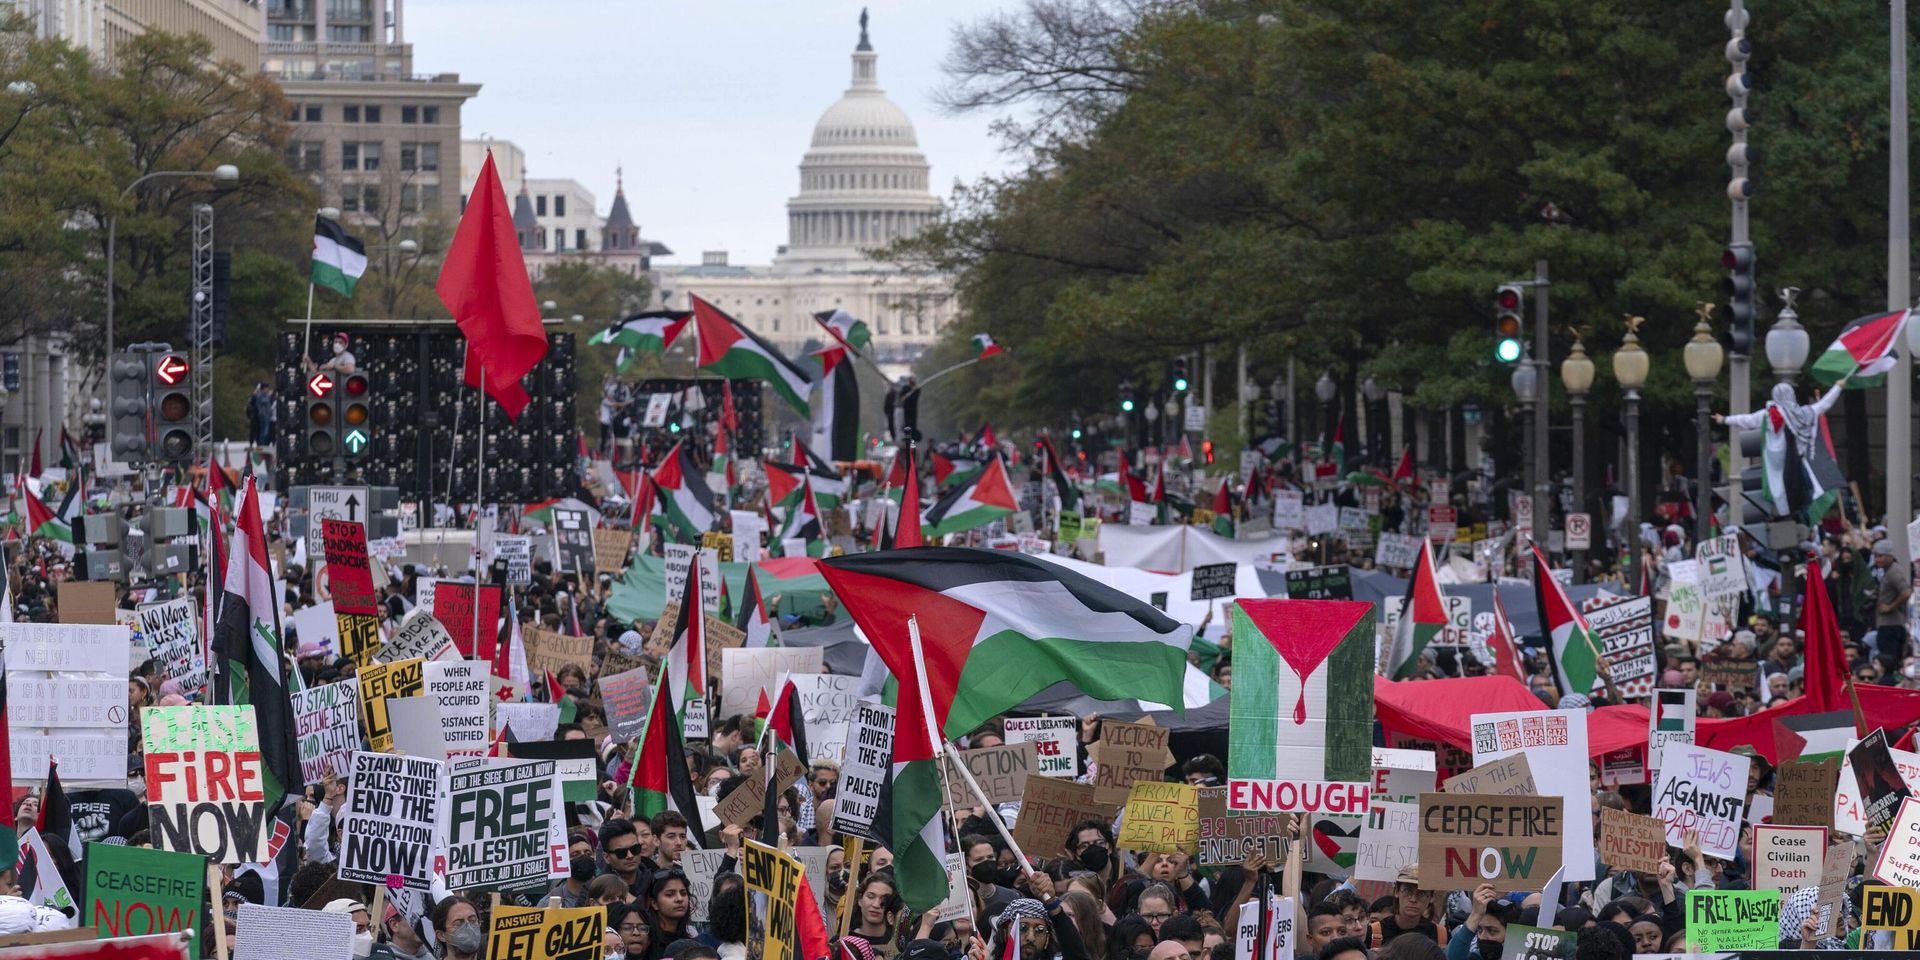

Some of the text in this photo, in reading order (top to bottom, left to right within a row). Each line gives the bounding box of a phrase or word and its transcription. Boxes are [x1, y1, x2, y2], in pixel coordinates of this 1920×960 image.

[313, 492, 339, 503] THRU
[329, 522, 358, 538] STOP
[323, 537, 366, 553] FUNDING
[326, 555, 369, 569] GENOCIDE
[141, 605, 190, 634] NO More
[154, 626, 184, 645] USA
[190, 633, 200, 655] 4
[379, 613, 434, 663] JOE BIDEN
[168, 663, 193, 679] thnic
[362, 666, 387, 681] ANSWER
[444, 666, 471, 677] WHEN
[67, 683, 91, 699] NO
[99, 684, 122, 699] TO
[362, 675, 388, 702] LET
[430, 680, 484, 692] PEOPLE ARE
[817, 675, 849, 691] NO
[306, 683, 339, 713] STAND
[342, 699, 356, 721] TO
[858, 707, 890, 731] FROM
[144, 707, 258, 754] CEASE
[441, 716, 485, 728] SISTANCE
[1005, 719, 1075, 731] QUEER LIBERATION
[297, 722, 357, 761] TAND WITH
[444, 730, 484, 742] USTIFIED
[858, 726, 889, 749] RIVER
[1103, 725, 1166, 750] VICTORY
[1500, 731, 1520, 742] GAZA
[1524, 729, 1544, 739] GAZA
[1525, 738, 1545, 747] DIES
[1547, 728, 1567, 738] GAZA
[1547, 737, 1568, 745] DIES
[1036, 741, 1061, 756] REE
[1477, 740, 1498, 753] GAZA
[1502, 740, 1522, 751] DIES
[455, 760, 480, 770] ANSWER
[858, 746, 877, 767] THE
[1126, 751, 1142, 766] TO
[356, 755, 438, 780] STAND WITH
[453, 761, 553, 790] END THE SIEGE ON GAZA NOW!
[1486, 762, 1520, 784] THE
[1687, 753, 1733, 790] JEWS
[1781, 767, 1825, 783] WHAT IF
[353, 772, 437, 799] PALESTINE!
[1134, 783, 1181, 801] FROM
[1778, 785, 1829, 800] PALESTINE
[71, 802, 111, 814] FREE
[351, 789, 436, 824] END THE
[723, 792, 747, 824] FREE
[1230, 781, 1369, 814] ENOUGH
[1658, 776, 1743, 822] AGAINST
[450, 778, 552, 845] FREE
[840, 798, 876, 820] WILL BE
[1022, 801, 1062, 826] FREE
[1130, 802, 1198, 822] RIVER TO
[348, 818, 433, 845] OCCUPATION
[1125, 821, 1154, 842] SEA
[1391, 811, 1418, 832] FRE
[1603, 823, 1654, 840] TO THE SEA
[1655, 805, 1736, 850] APARTHEID
[151, 802, 266, 864] NOW
[1771, 835, 1807, 847] Cease
[345, 834, 429, 879] NOW!
[449, 831, 549, 871] PALESTINE!
[1604, 852, 1632, 868] WILL
[1767, 851, 1810, 863] Civilian
[449, 859, 547, 888] END ALL U.S. AID TO ISRAEL
[1445, 847, 1538, 880] NOW
[1771, 867, 1806, 878] Death
[95, 870, 196, 899] CEASEFIRE
[744, 846, 800, 908] END THE
[1778, 884, 1799, 894] and
[95, 898, 195, 938] NOW
[1693, 895, 1733, 924] FREE
[1866, 890, 1913, 927] END
[497, 913, 542, 929] ANSWER
[769, 899, 793, 945] WAR
[491, 912, 601, 960] LET GAZA
[1524, 932, 1560, 951] STOP
[1697, 928, 1708, 936] NO
